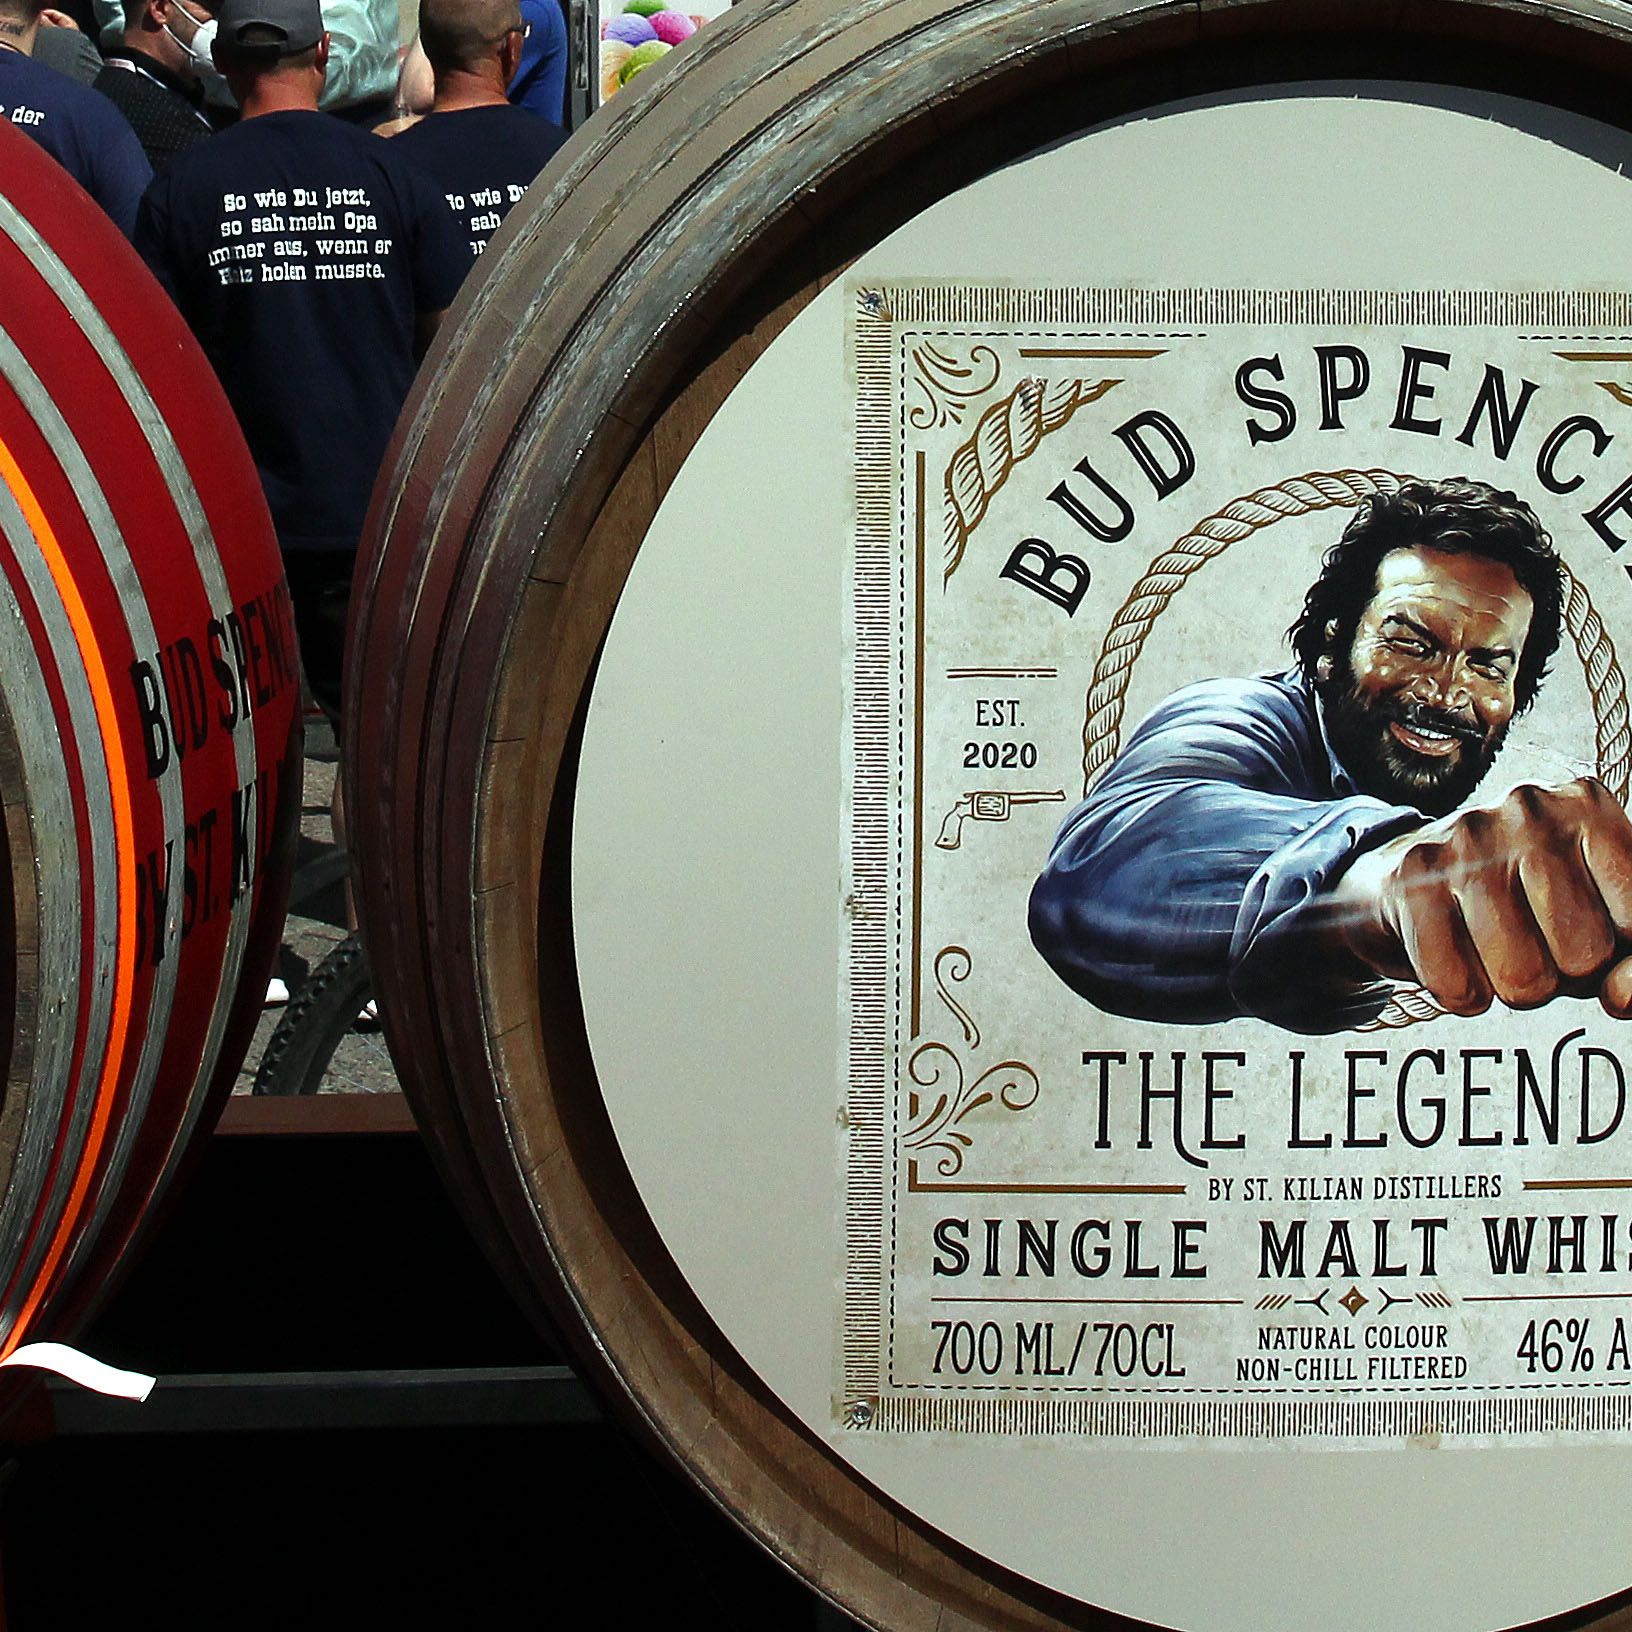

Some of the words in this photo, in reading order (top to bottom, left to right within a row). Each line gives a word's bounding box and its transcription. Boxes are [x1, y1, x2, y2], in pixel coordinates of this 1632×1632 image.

[11, 105, 45, 126] der
[224, 193, 247, 213] So
[254, 189, 287, 207] wie
[292, 188, 318, 207] Du
[325, 187, 371, 209] jetzt,
[470, 187, 502, 207] wie
[220, 219, 243, 237] so
[251, 213, 285, 233] sah
[288, 212, 335, 232] mein
[344, 212, 377, 233] Opa
[315, 239, 369, 255] wenn
[374, 239, 393, 255] er
[261, 261, 307, 282] holen
[315, 261, 385, 280] musste.
[1000, 408, 1196, 617] BUD
[127, 636, 208, 780] BUD
[975, 699, 1025, 727] EST.
[963, 742, 1038, 769] 2020
[1082, 1049, 1246, 1168] THE
[1287, 1029, 1626, 1149] LEGEND
[1208, 1178, 1234, 1202] BY
[1243, 1177, 1273, 1202] ST.
[1283, 1177, 1363, 1201] KILIAN
[1373, 1174, 1502, 1200] DISTILLERS
[932, 1218, 1208, 1279] SINGLE
[1257, 1217, 1448, 1279] MALT
[931, 1320, 1003, 1375] 700
[1014, 1322, 1186, 1378] ML/70CL
[1258, 1326, 1356, 1351] NATURAL
[1364, 1325, 1448, 1349] COLOUR
[1516, 1318, 1594, 1373] 46%
[1236, 1357, 1358, 1382] NON-CHILL
[1367, 1355, 1467, 1380] FILTERED
